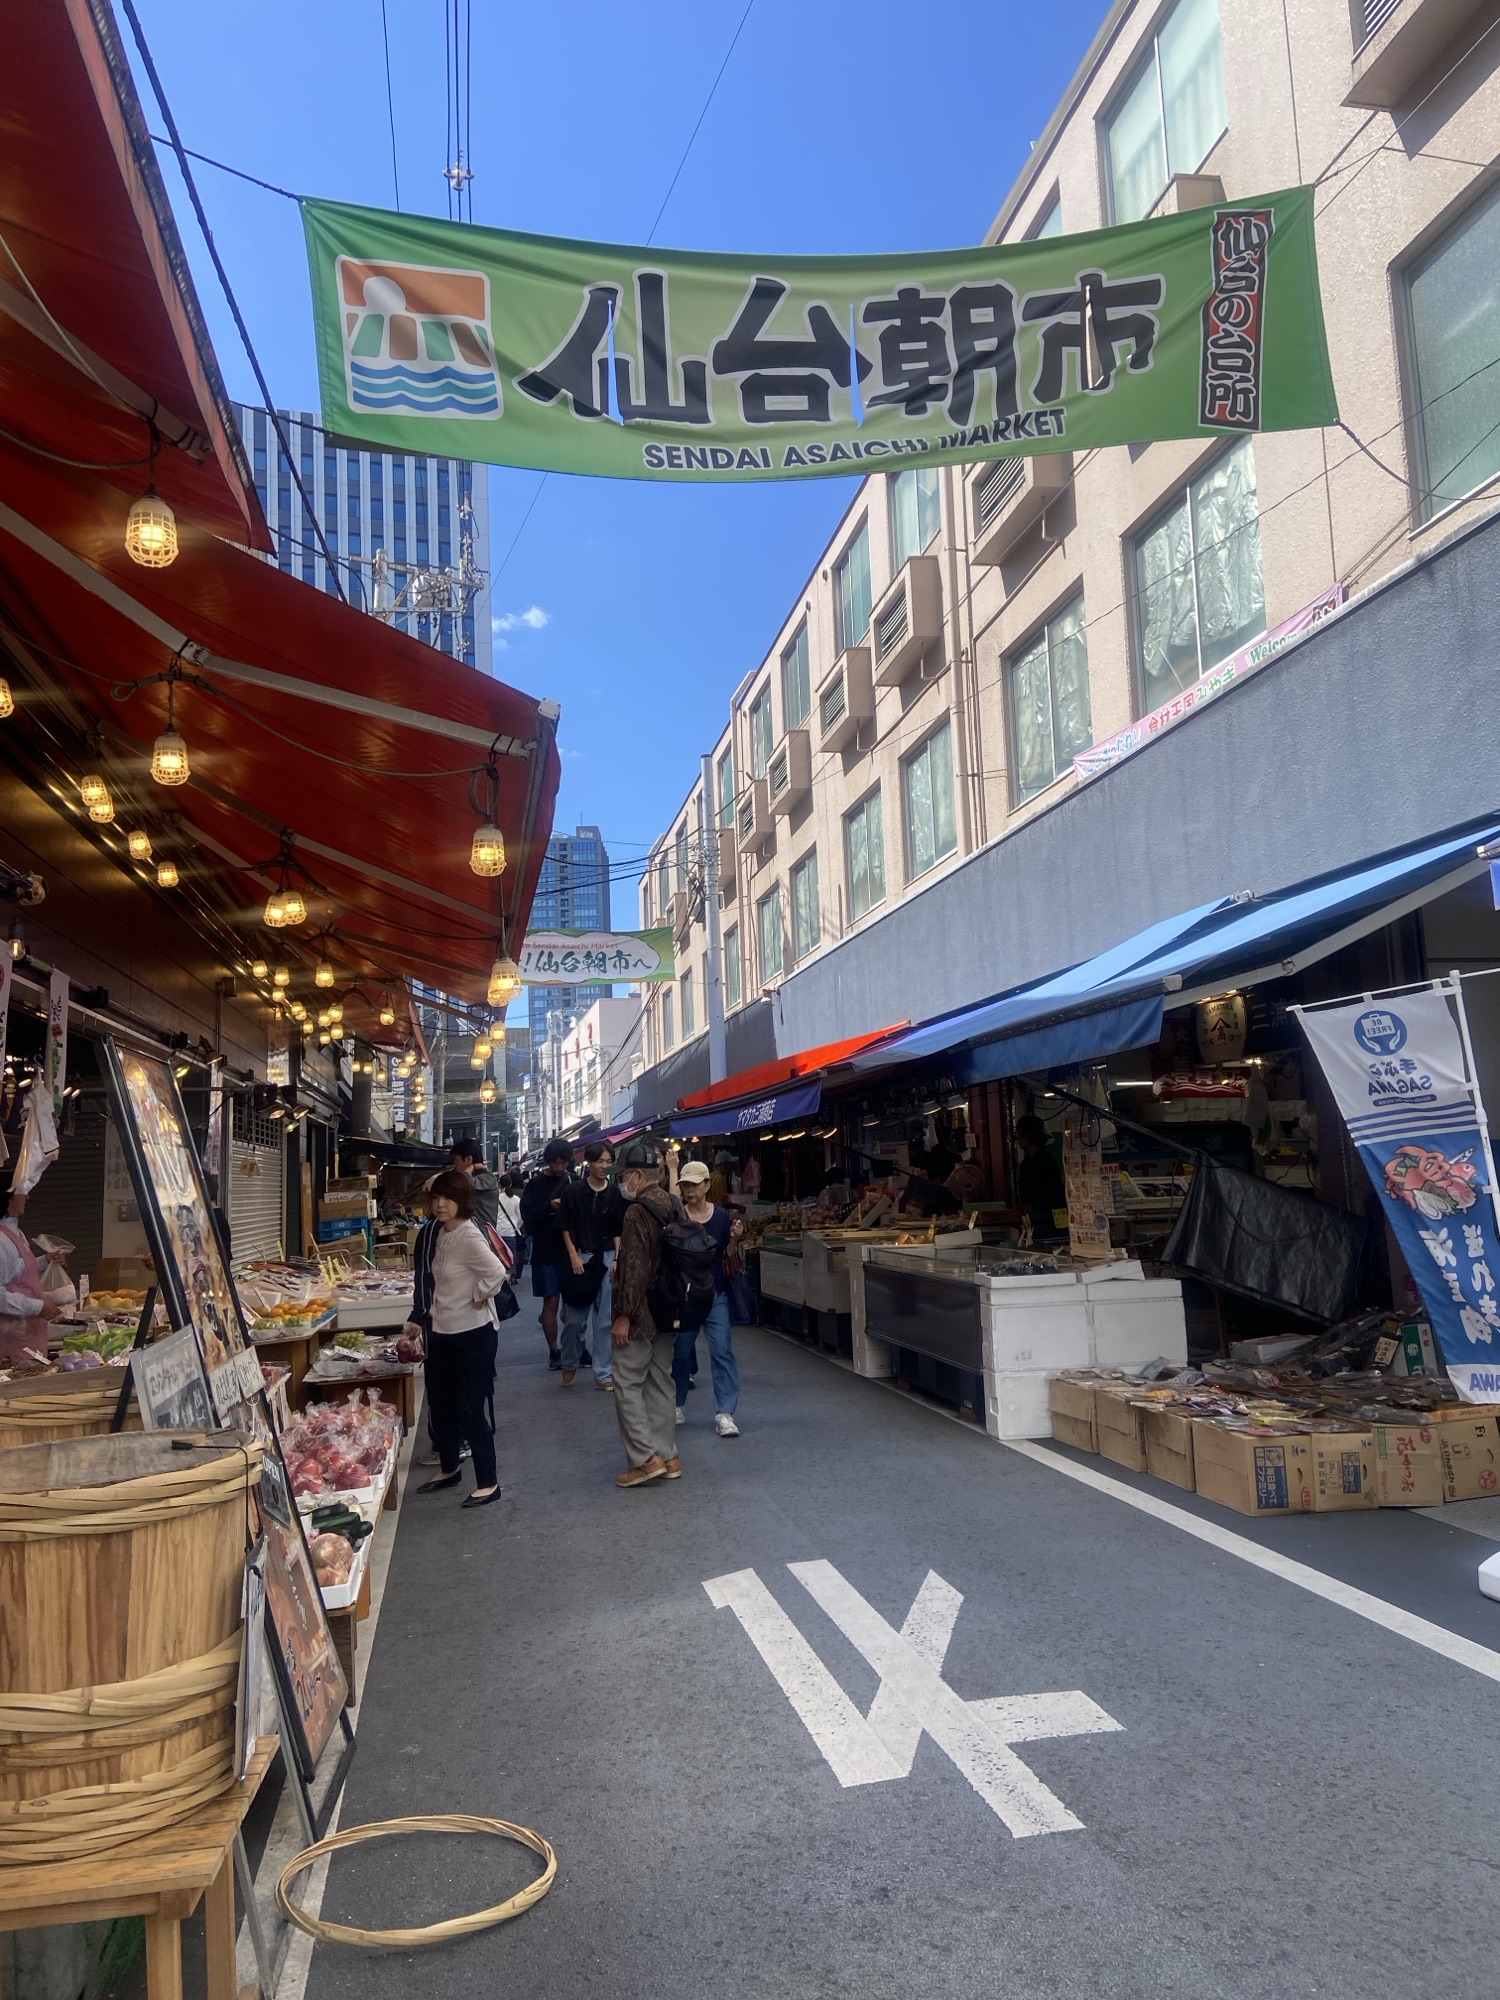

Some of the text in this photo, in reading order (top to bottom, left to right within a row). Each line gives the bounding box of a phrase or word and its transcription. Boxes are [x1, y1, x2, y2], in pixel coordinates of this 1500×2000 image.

[514, 268, 1165, 427] 仙台朝市
[1205, 215, 1274, 423] 仙台の台所
[644, 408, 1066, 473] SENDAI ASAICHI MARKET
[561, 942, 590, 950] Asaichi
[591, 942, 619, 950] Market
[262, 1455, 281, 1482] OPEN
